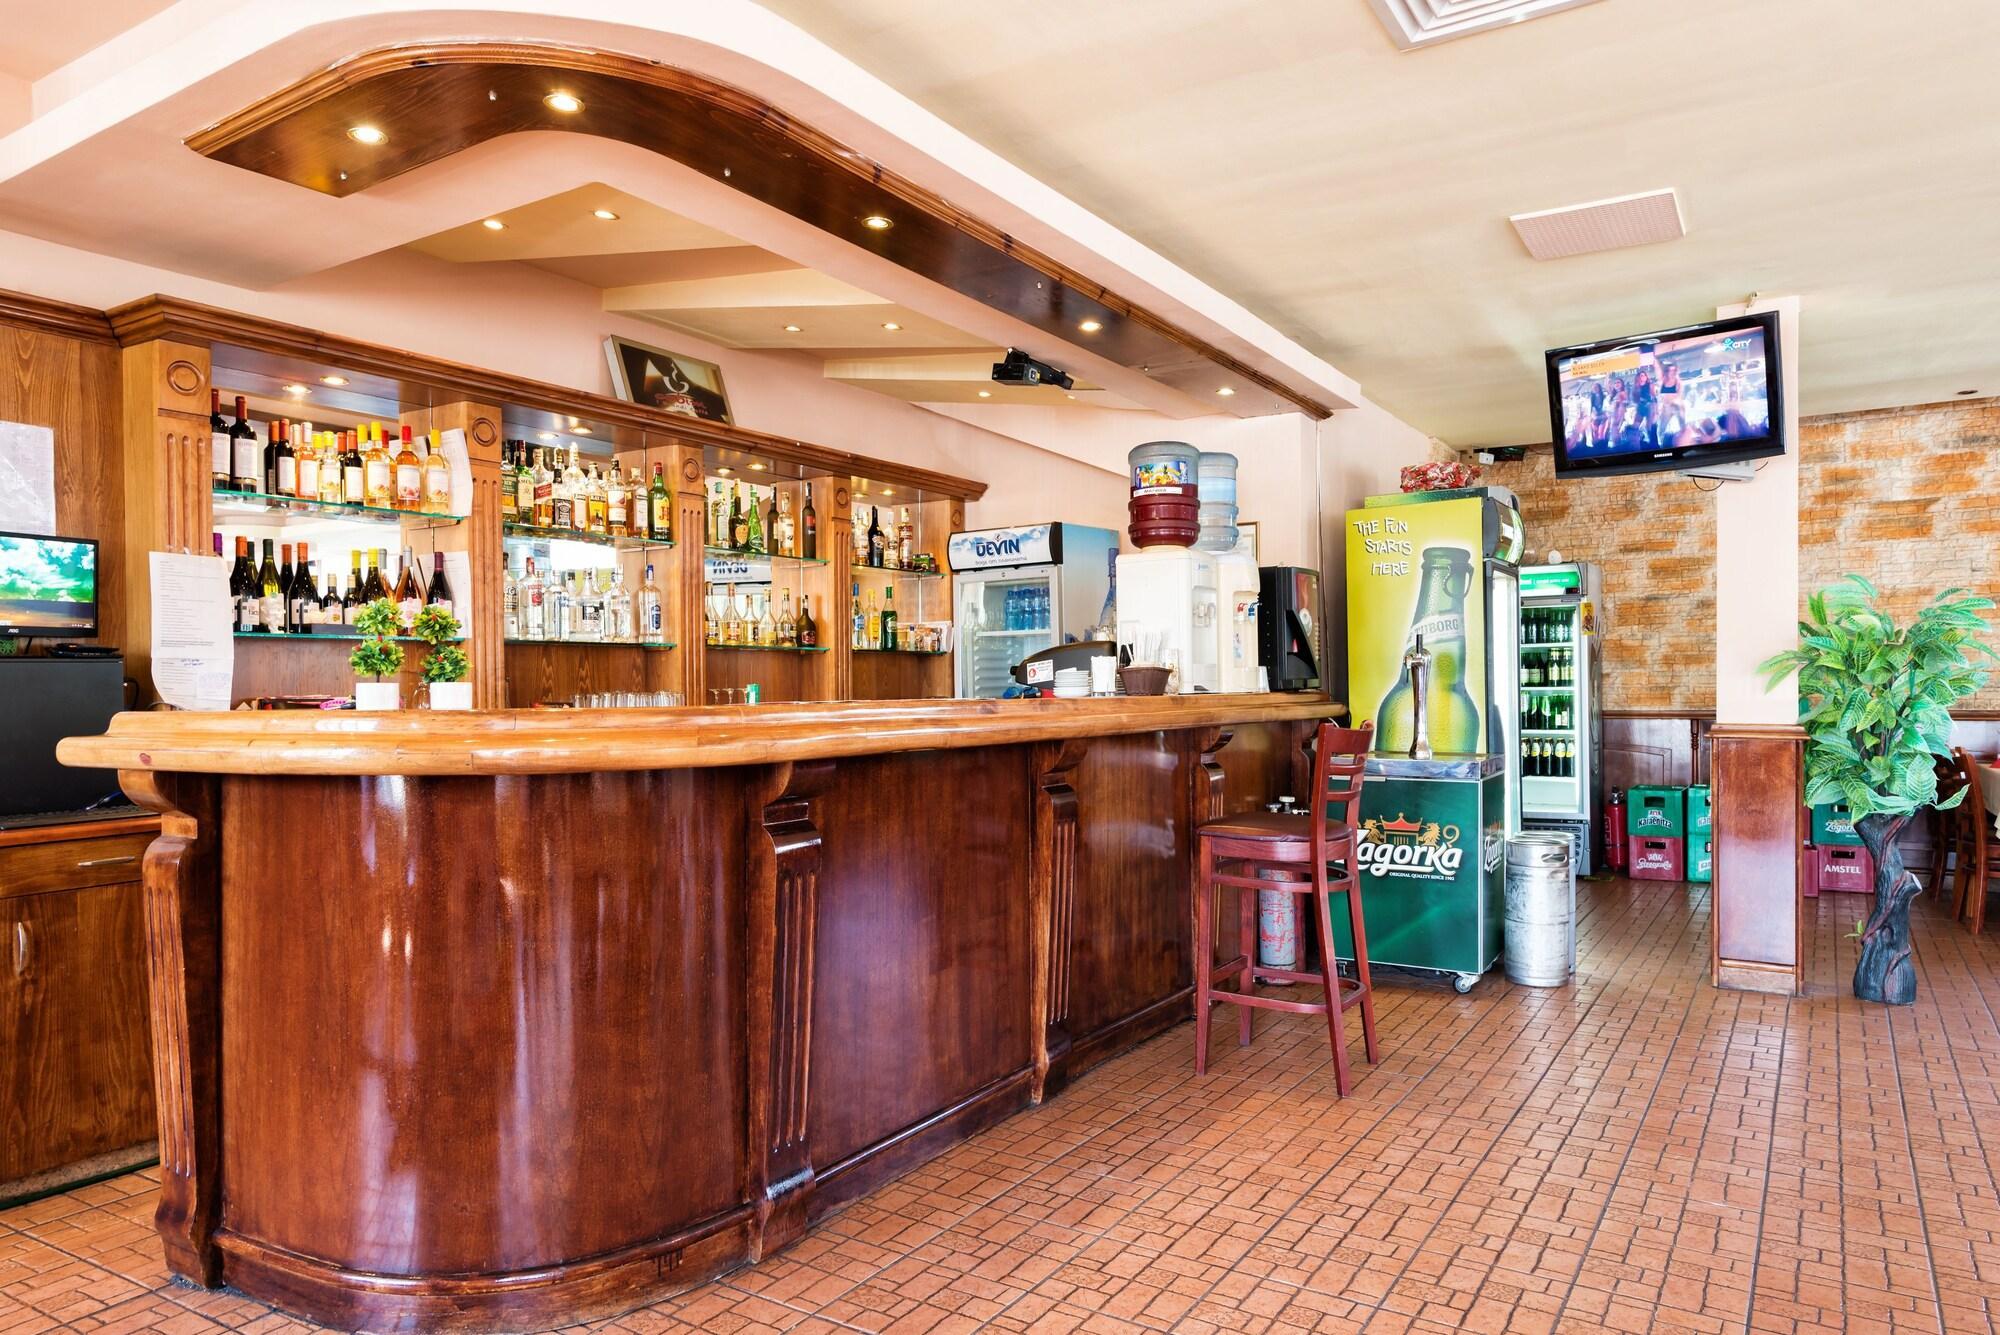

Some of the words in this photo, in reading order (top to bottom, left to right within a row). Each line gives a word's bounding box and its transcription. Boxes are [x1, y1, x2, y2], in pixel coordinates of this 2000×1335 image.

[1732, 339, 1751, 348] CITY
[1353, 519, 1380, 537] THE
[1384, 516, 1408, 535] FUN
[975, 539, 1020, 557] DEVIN
[1365, 538, 1413, 557] STARTS
[1371, 560, 1409, 577] HERE
[1824, 863, 1862, 874] AMSTEL
